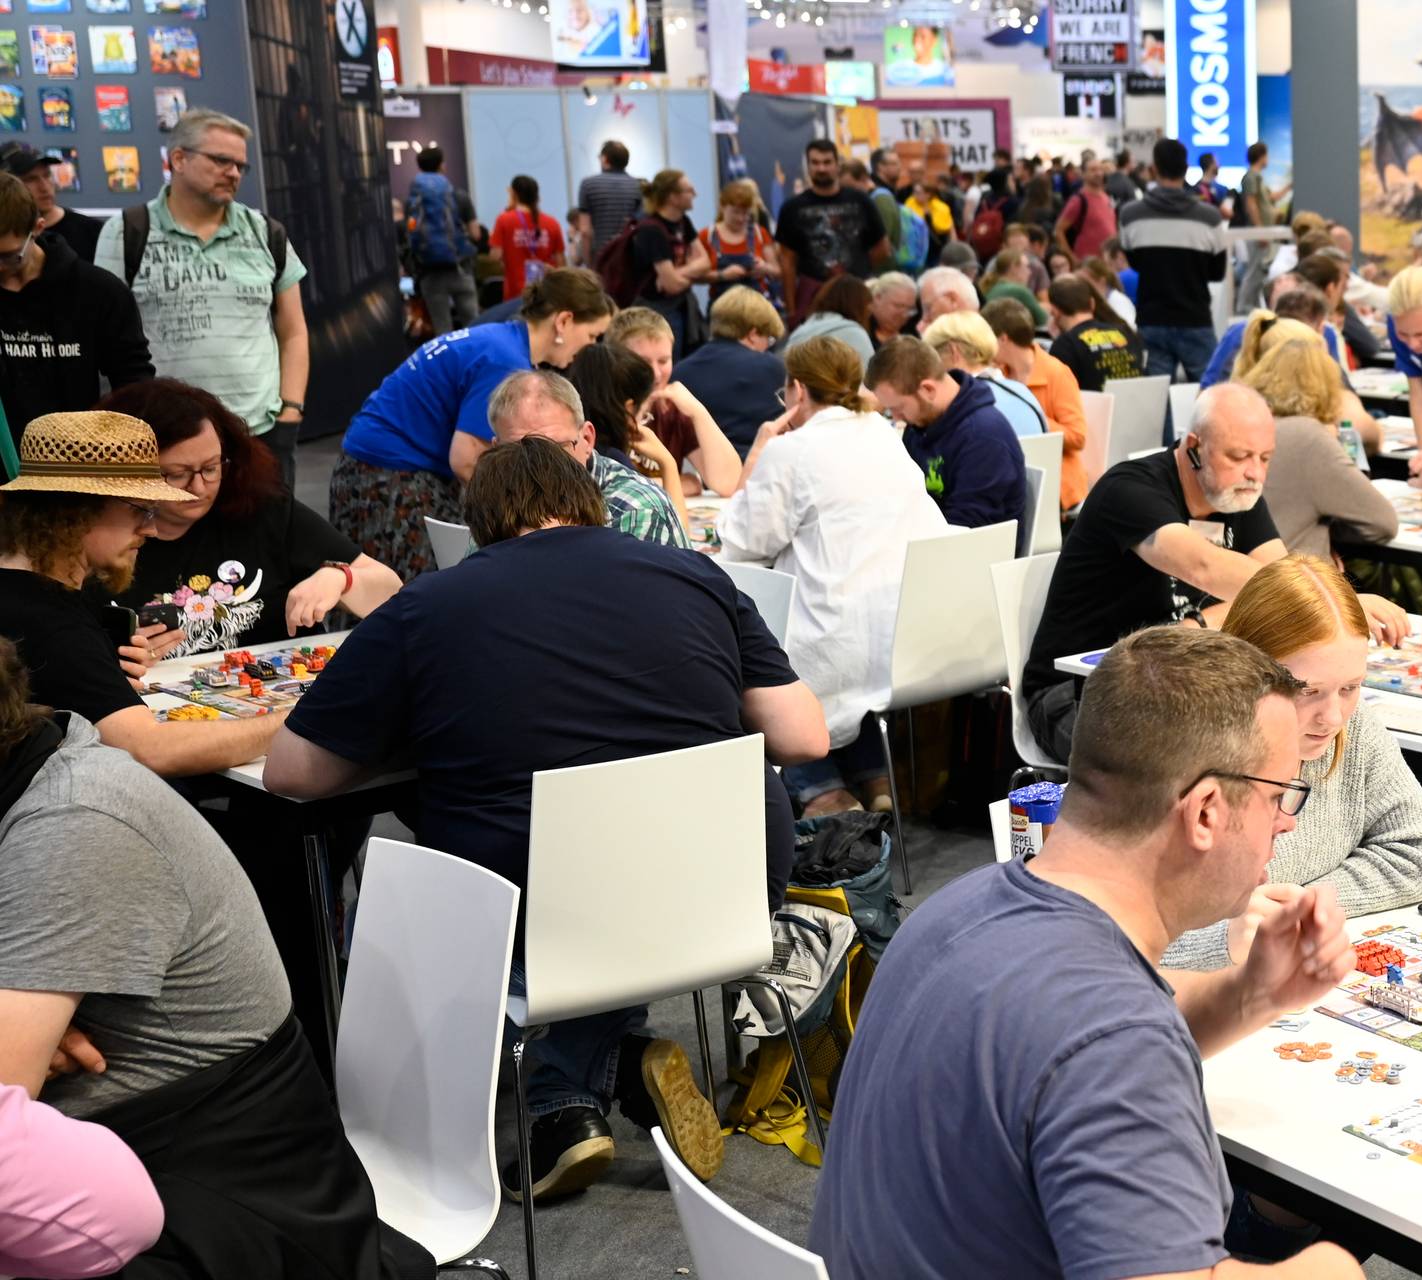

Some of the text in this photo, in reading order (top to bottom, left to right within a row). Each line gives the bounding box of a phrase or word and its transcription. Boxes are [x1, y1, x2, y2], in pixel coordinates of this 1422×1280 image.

[1060, 21, 1120, 35] WE ARE
[163, 264, 227, 291] DAVID
[5, 343, 37, 358] HAAR
